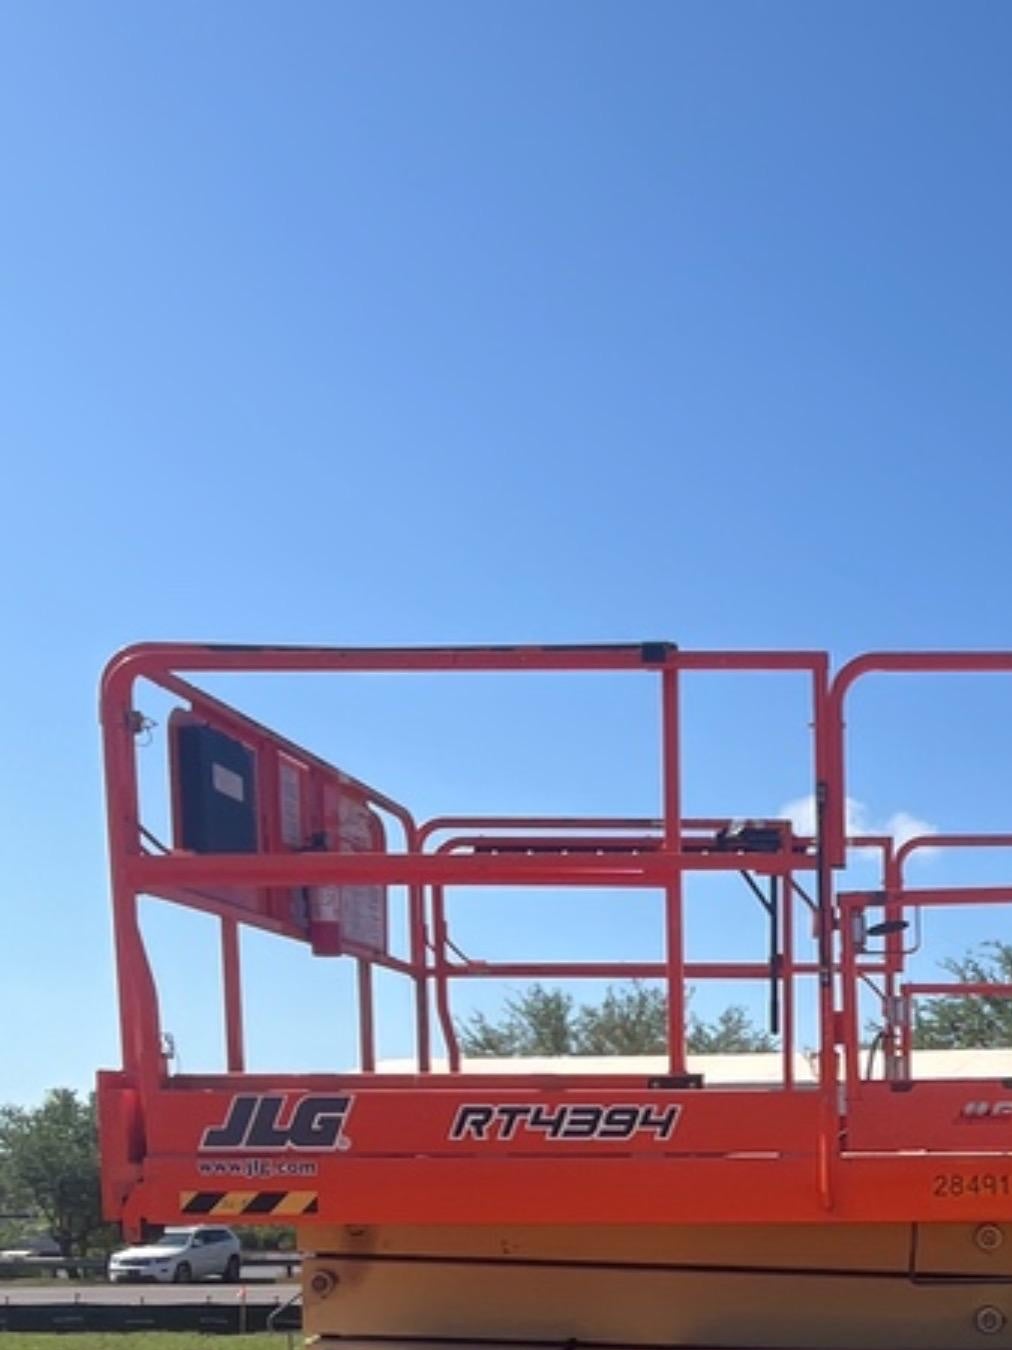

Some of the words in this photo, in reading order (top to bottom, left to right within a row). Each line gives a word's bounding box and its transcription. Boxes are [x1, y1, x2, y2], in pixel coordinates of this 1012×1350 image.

[199, 1094, 355, 1151] JLG
[449, 1104, 681, 1141] RT4394
[199, 1160, 317, 1178] www.jlg.com
